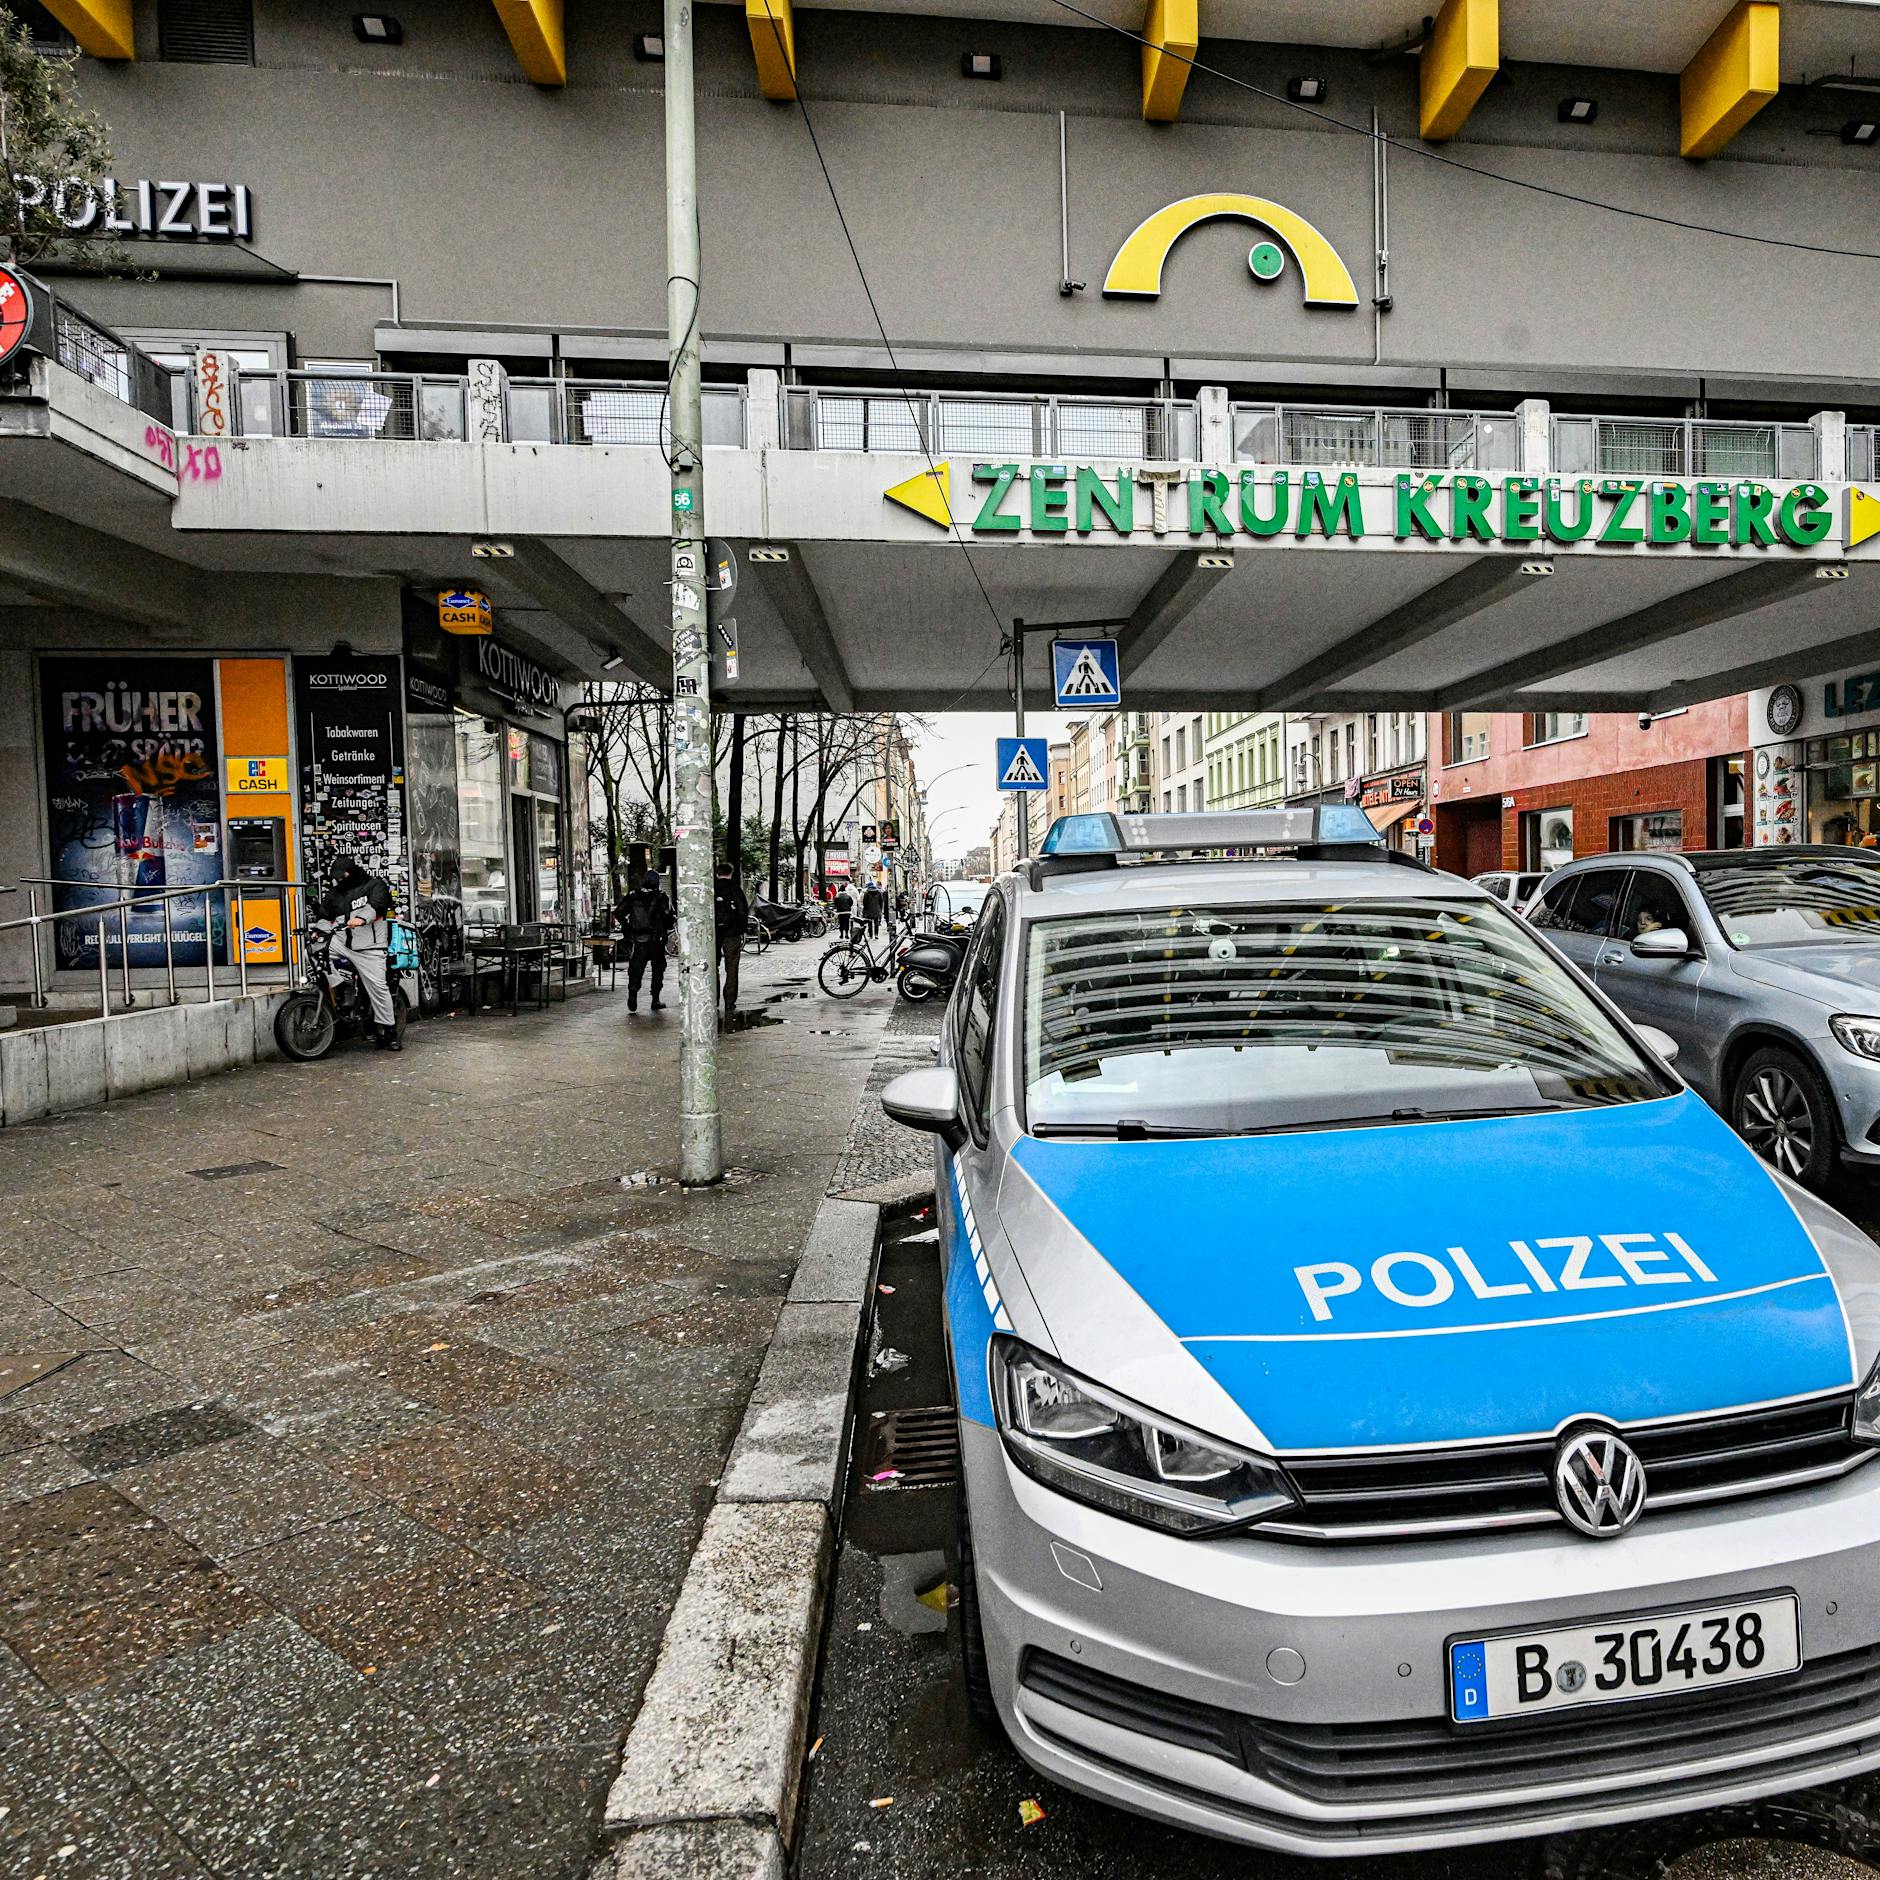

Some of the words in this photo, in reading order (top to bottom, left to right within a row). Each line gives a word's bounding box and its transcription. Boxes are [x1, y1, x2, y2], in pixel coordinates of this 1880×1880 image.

[13, 174, 249, 236] POLIZEI
[674, 493, 690, 506] 56
[972, 463, 1366, 538] ZENTRUM
[1394, 473, 1834, 547] KREUZBERG
[443, 612, 475, 622] CASH
[478, 636, 560, 707] KOTTIWOOD
[309, 674, 387, 684] KOTTIWOOD
[410, 676, 447, 702] KOTTIWOOD
[62, 681, 204, 732] FRÜHER
[325, 725, 379, 738] Tabakwaren
[331, 748, 376, 761] Getränke
[238, 779, 277, 790] CASH
[323, 774, 385, 785] Weinsortiment
[1393, 779, 1419, 788] OPEN
[1393, 788, 1402, 796] 24
[1403, 788, 1419, 796] Hours
[332, 797, 379, 810] Zeitungen
[1502, 796, 1515, 808] 56A
[332, 820, 381, 832] Spirituosen
[334, 842, 381, 855] Süßwaren
[1293, 1232, 1718, 1321] POLIZEI
[1465, 1689, 1478, 1706] D
[1515, 1643, 1553, 1703] B
[1594, 1612, 1766, 1692] 30438
